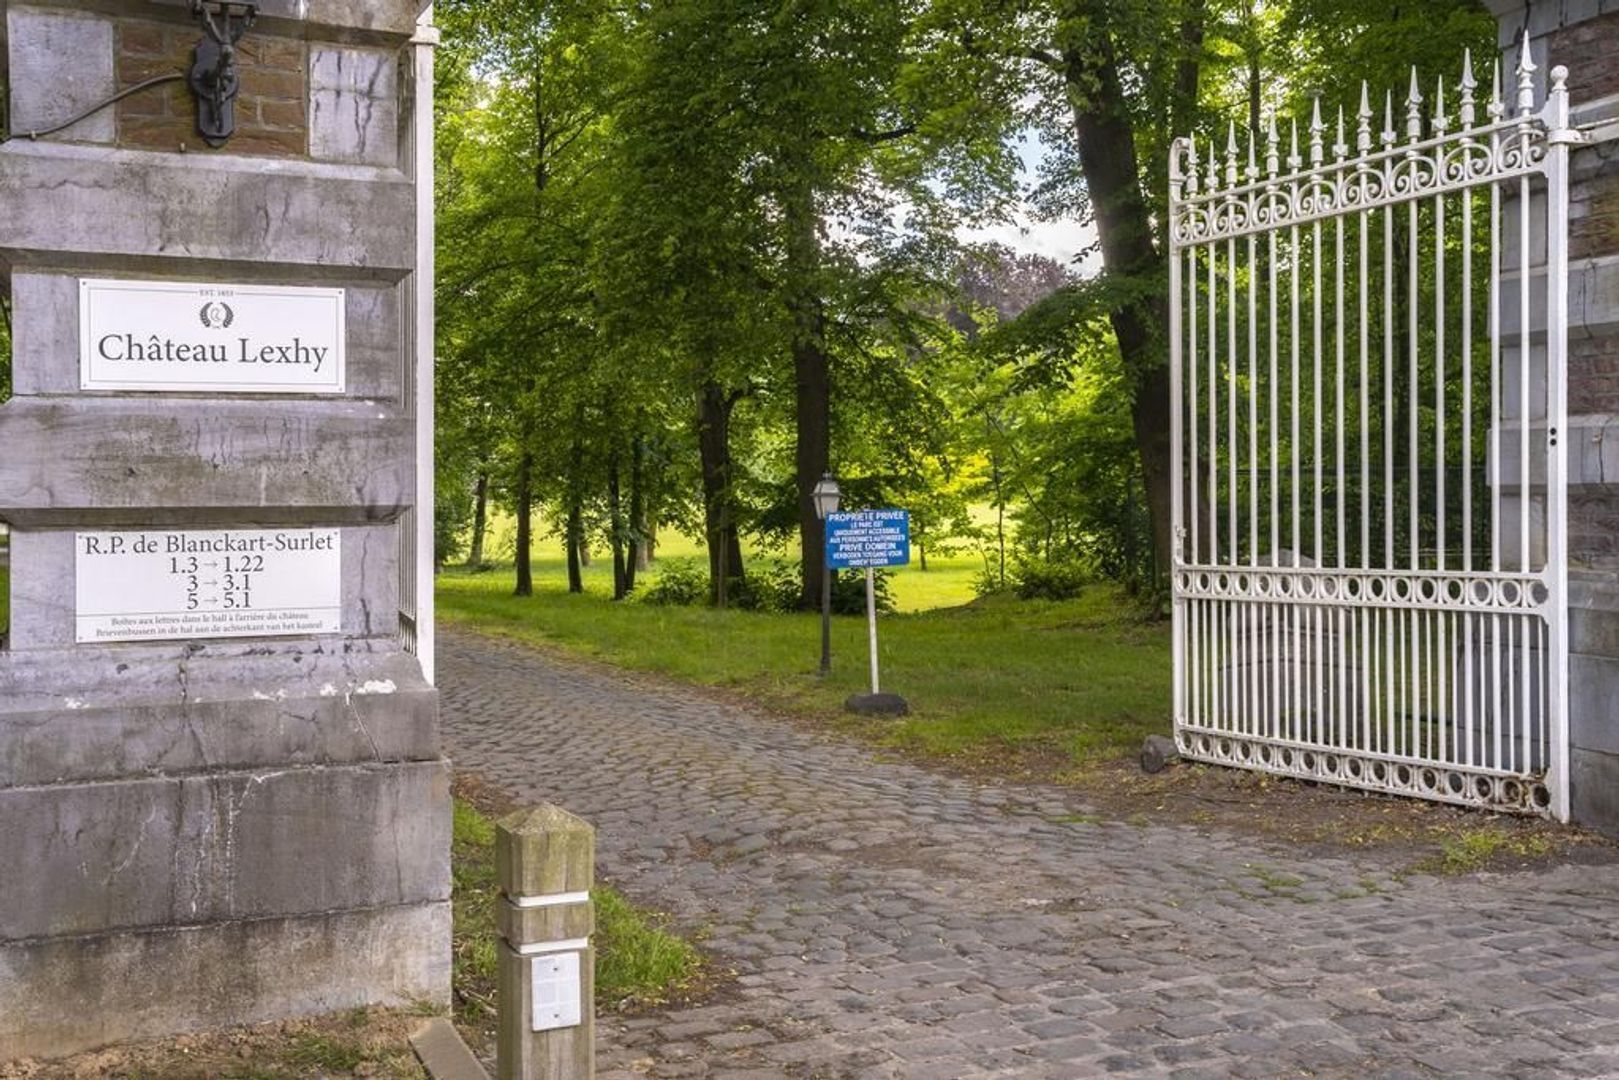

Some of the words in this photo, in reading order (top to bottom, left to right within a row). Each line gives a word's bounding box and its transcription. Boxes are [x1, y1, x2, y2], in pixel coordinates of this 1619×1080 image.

[98, 334, 228, 362] Château
[238, 338, 328, 372] Lexhy
[86, 536, 126, 554] R.P.
[132, 534, 158, 553] de
[166, 532, 333, 552] Blanckart-Surlet
[864, 542, 896, 550] DOMEIN
[170, 556, 198, 573] 1.3
[224, 555, 264, 572] 1.22
[833, 552, 862, 560] VERBODEN
[862, 550, 886, 558] TOEGANG
[888, 550, 902, 558] VOOR
[187, 575, 198, 592] 3
[223, 574, 250, 590] 3.1
[187, 593, 198, 610] 5
[224, 592, 250, 608] 5.1
[155, 616, 180, 624] lettres
[182, 614, 200, 622] dans
[202, 614, 210, 622] le
[212, 614, 227, 622] hall
[96, 626, 156, 636] Brievenbussen
[158, 626, 166, 634] in
[168, 626, 178, 634] de
[181, 625, 192, 633] hal
[223, 623, 264, 632] achterkant
[282, 622, 295, 630] het
